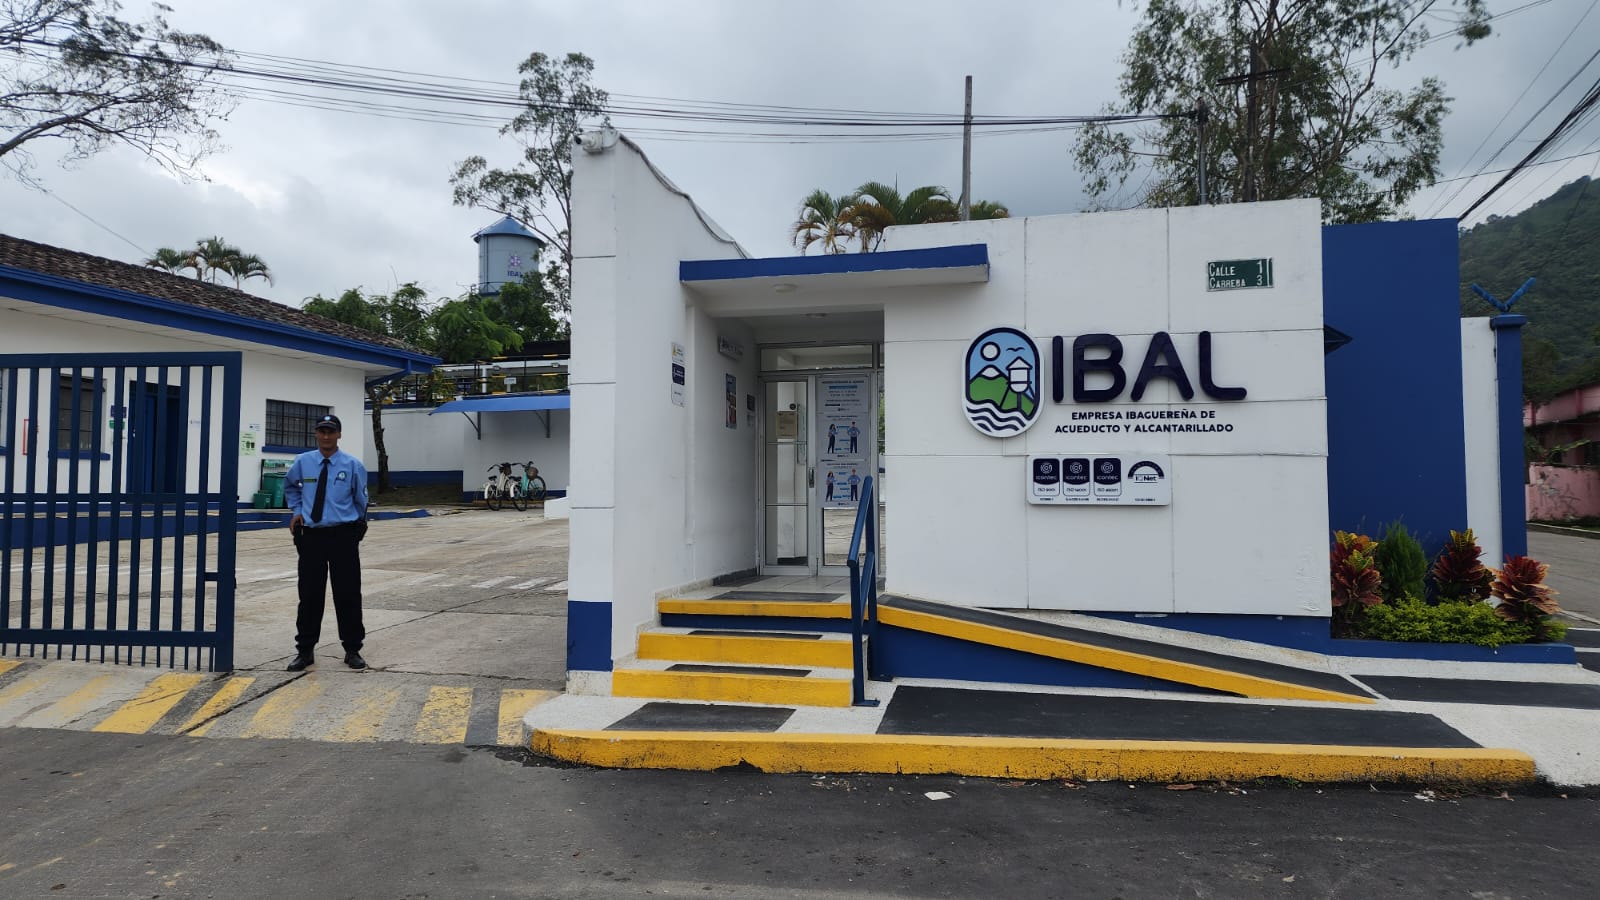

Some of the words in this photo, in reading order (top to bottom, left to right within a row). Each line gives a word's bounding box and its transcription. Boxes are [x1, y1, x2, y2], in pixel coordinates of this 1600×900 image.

[1256, 260, 1263, 274] 1
[1256, 275, 1263, 285] 3
[1052, 331, 1247, 403] IBAL
[1071, 411, 1122, 420] EMPRESA
[1126, 408, 1197, 420] IBAGUEREÑA
[1200, 410, 1216, 419] DE
[1055, 424, 1121, 433] ACUEDUCTO
[1124, 424, 1131, 433] Y
[1134, 423, 1234, 433] ALCANTARILLADO
